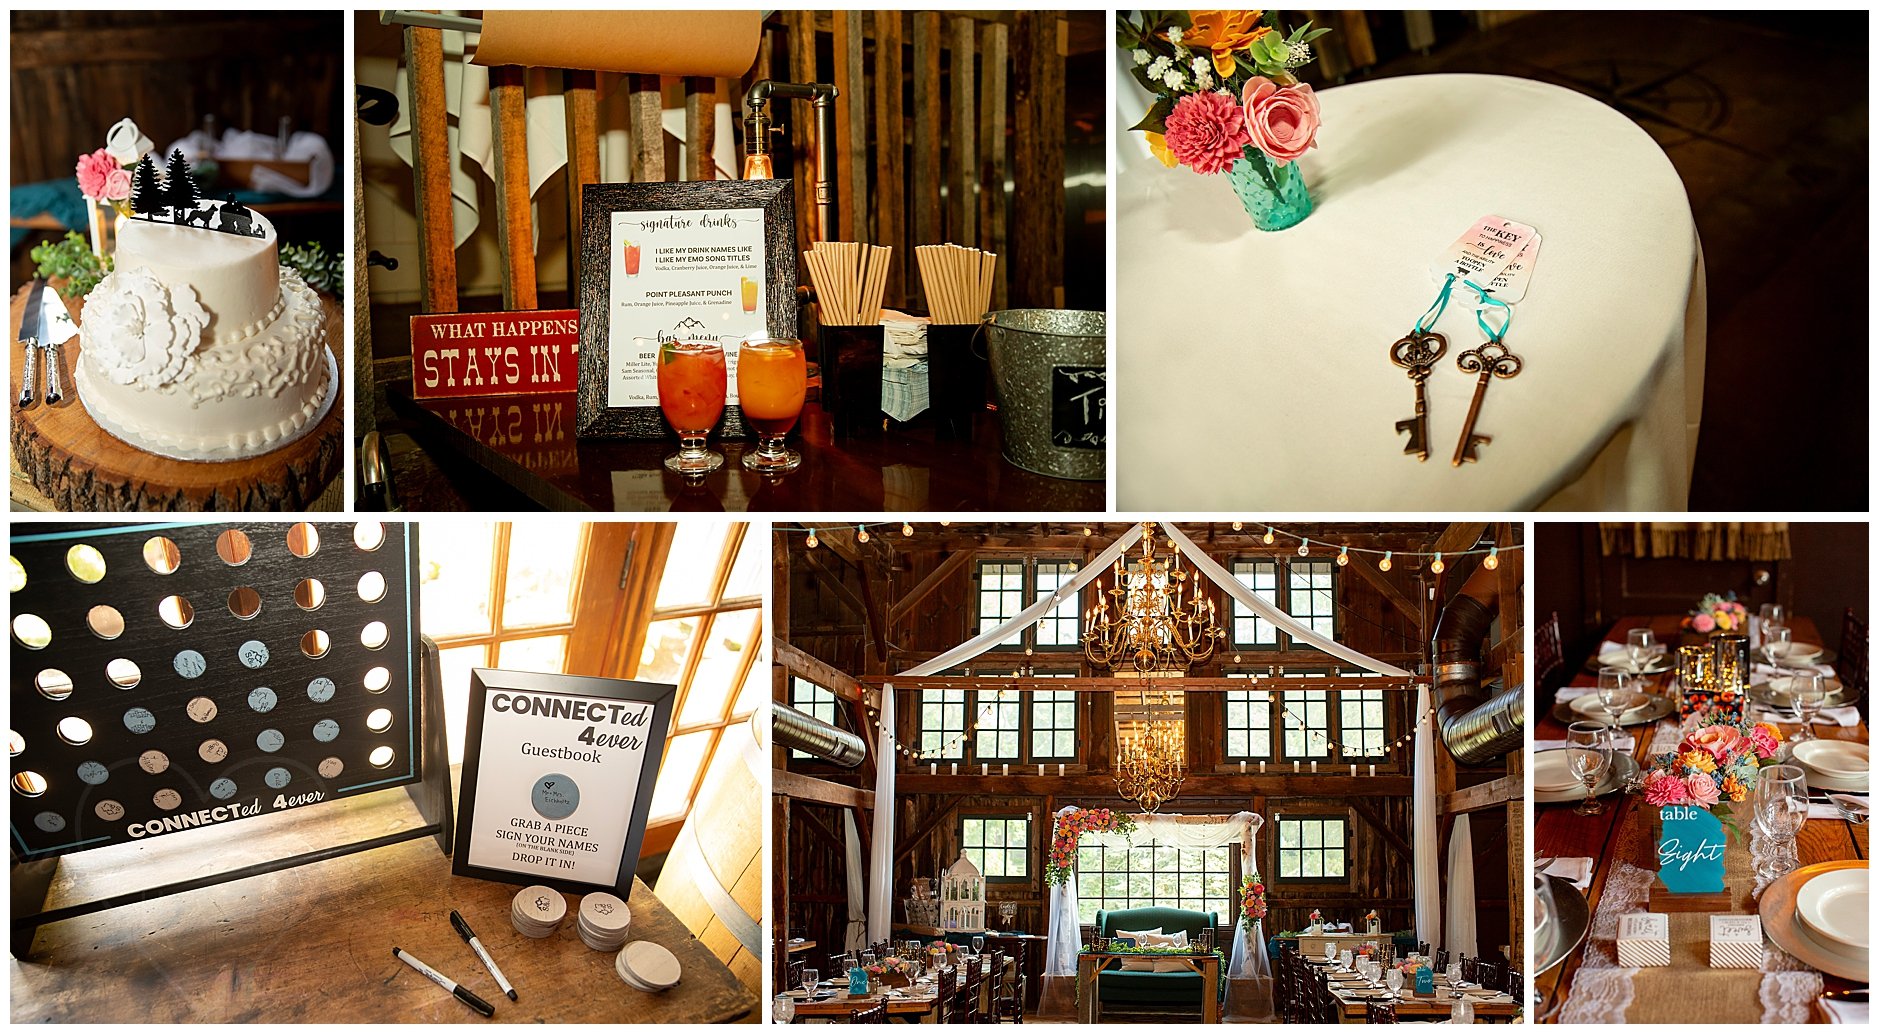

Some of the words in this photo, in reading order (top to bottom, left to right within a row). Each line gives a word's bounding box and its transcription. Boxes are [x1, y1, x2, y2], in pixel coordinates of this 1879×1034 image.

[640, 214, 692, 233] signature
[700, 213, 737, 228] drinks
[1483, 226, 1498, 234] THE
[1494, 230, 1522, 242] KEY
[1486, 236, 1512, 247] HAPPINESS
[1483, 246, 1506, 259] love
[1506, 263, 1524, 271] ve
[430, 322, 487, 339] WHAT
[492, 319, 578, 338] HAPPENS
[423, 346, 520, 388] STAYS
[530, 344, 561, 383] IN
[1070, 386, 1106, 425] Ti
[492, 693, 648, 727] CONNECTed
[578, 726, 644, 750] 4ever
[521, 742, 602, 763] Guestbook
[127, 798, 262, 838] CONNECTed
[273, 790, 325, 809] 4ever
[1659, 807, 1698, 821] table
[510, 817, 541, 830] GRAB
[543, 822, 552, 832] A
[554, 823, 589, 837] PIECE
[495, 829, 522, 842] SIGN
[525, 834, 555, 847] YOUR
[558, 839, 599, 853] NAMES
[512, 852, 543, 865] DROP
[545, 857, 557, 867] IT
[558, 859, 575, 869] IN!
[559, 848, 575, 856] SIDE)
[1658, 838, 1727, 871] Eight
